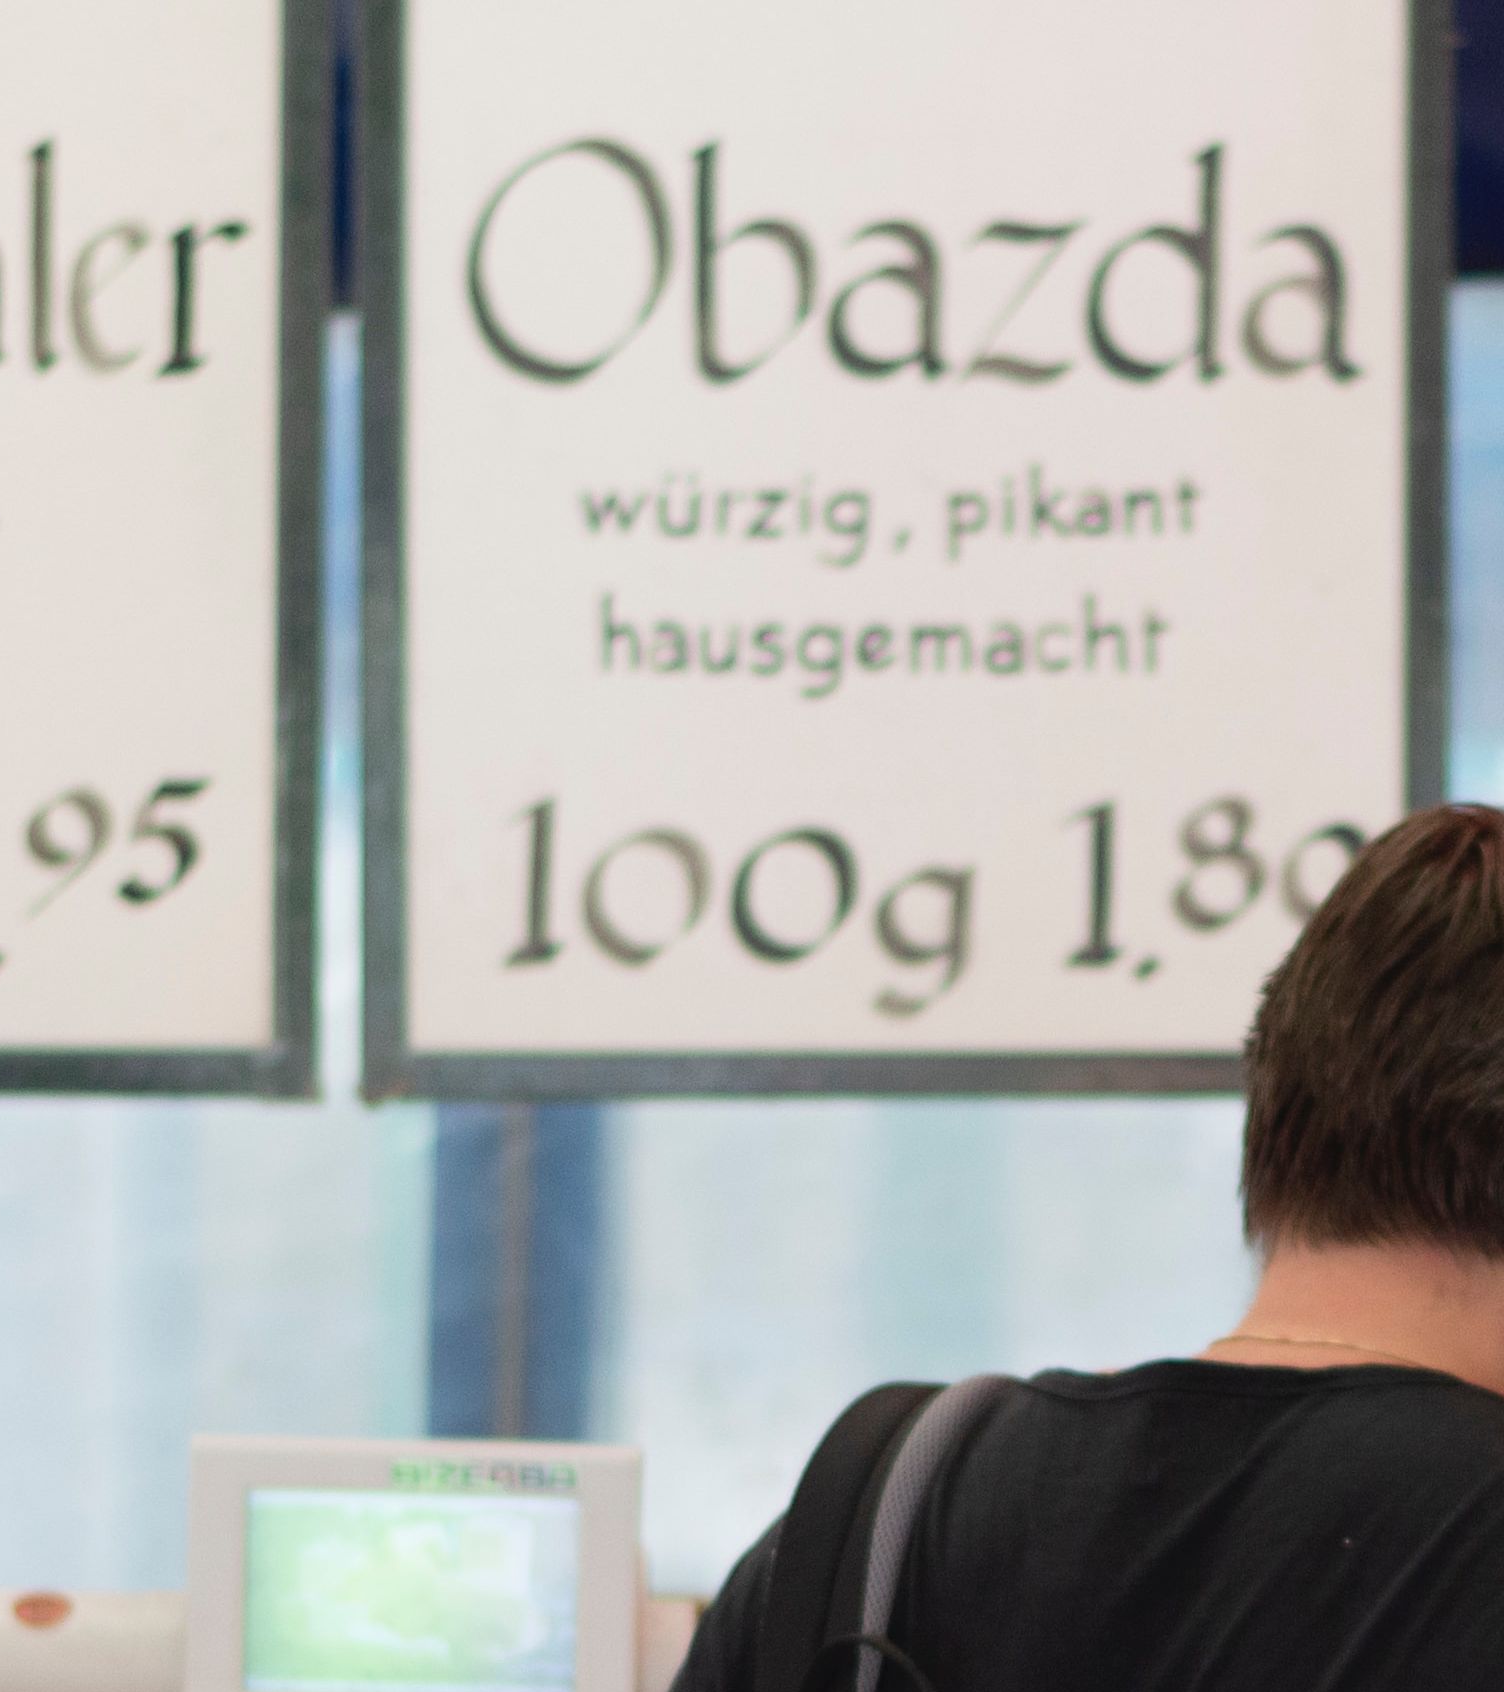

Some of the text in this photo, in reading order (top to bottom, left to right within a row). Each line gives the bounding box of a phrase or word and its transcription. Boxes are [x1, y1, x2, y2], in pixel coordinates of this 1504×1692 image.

[462, 135, 1367, 389] Obazda
[946, 460, 1202, 562] pikant
[599, 592, 1170, 702] hausgemacht
[500, 796, 978, 1021] 100g
